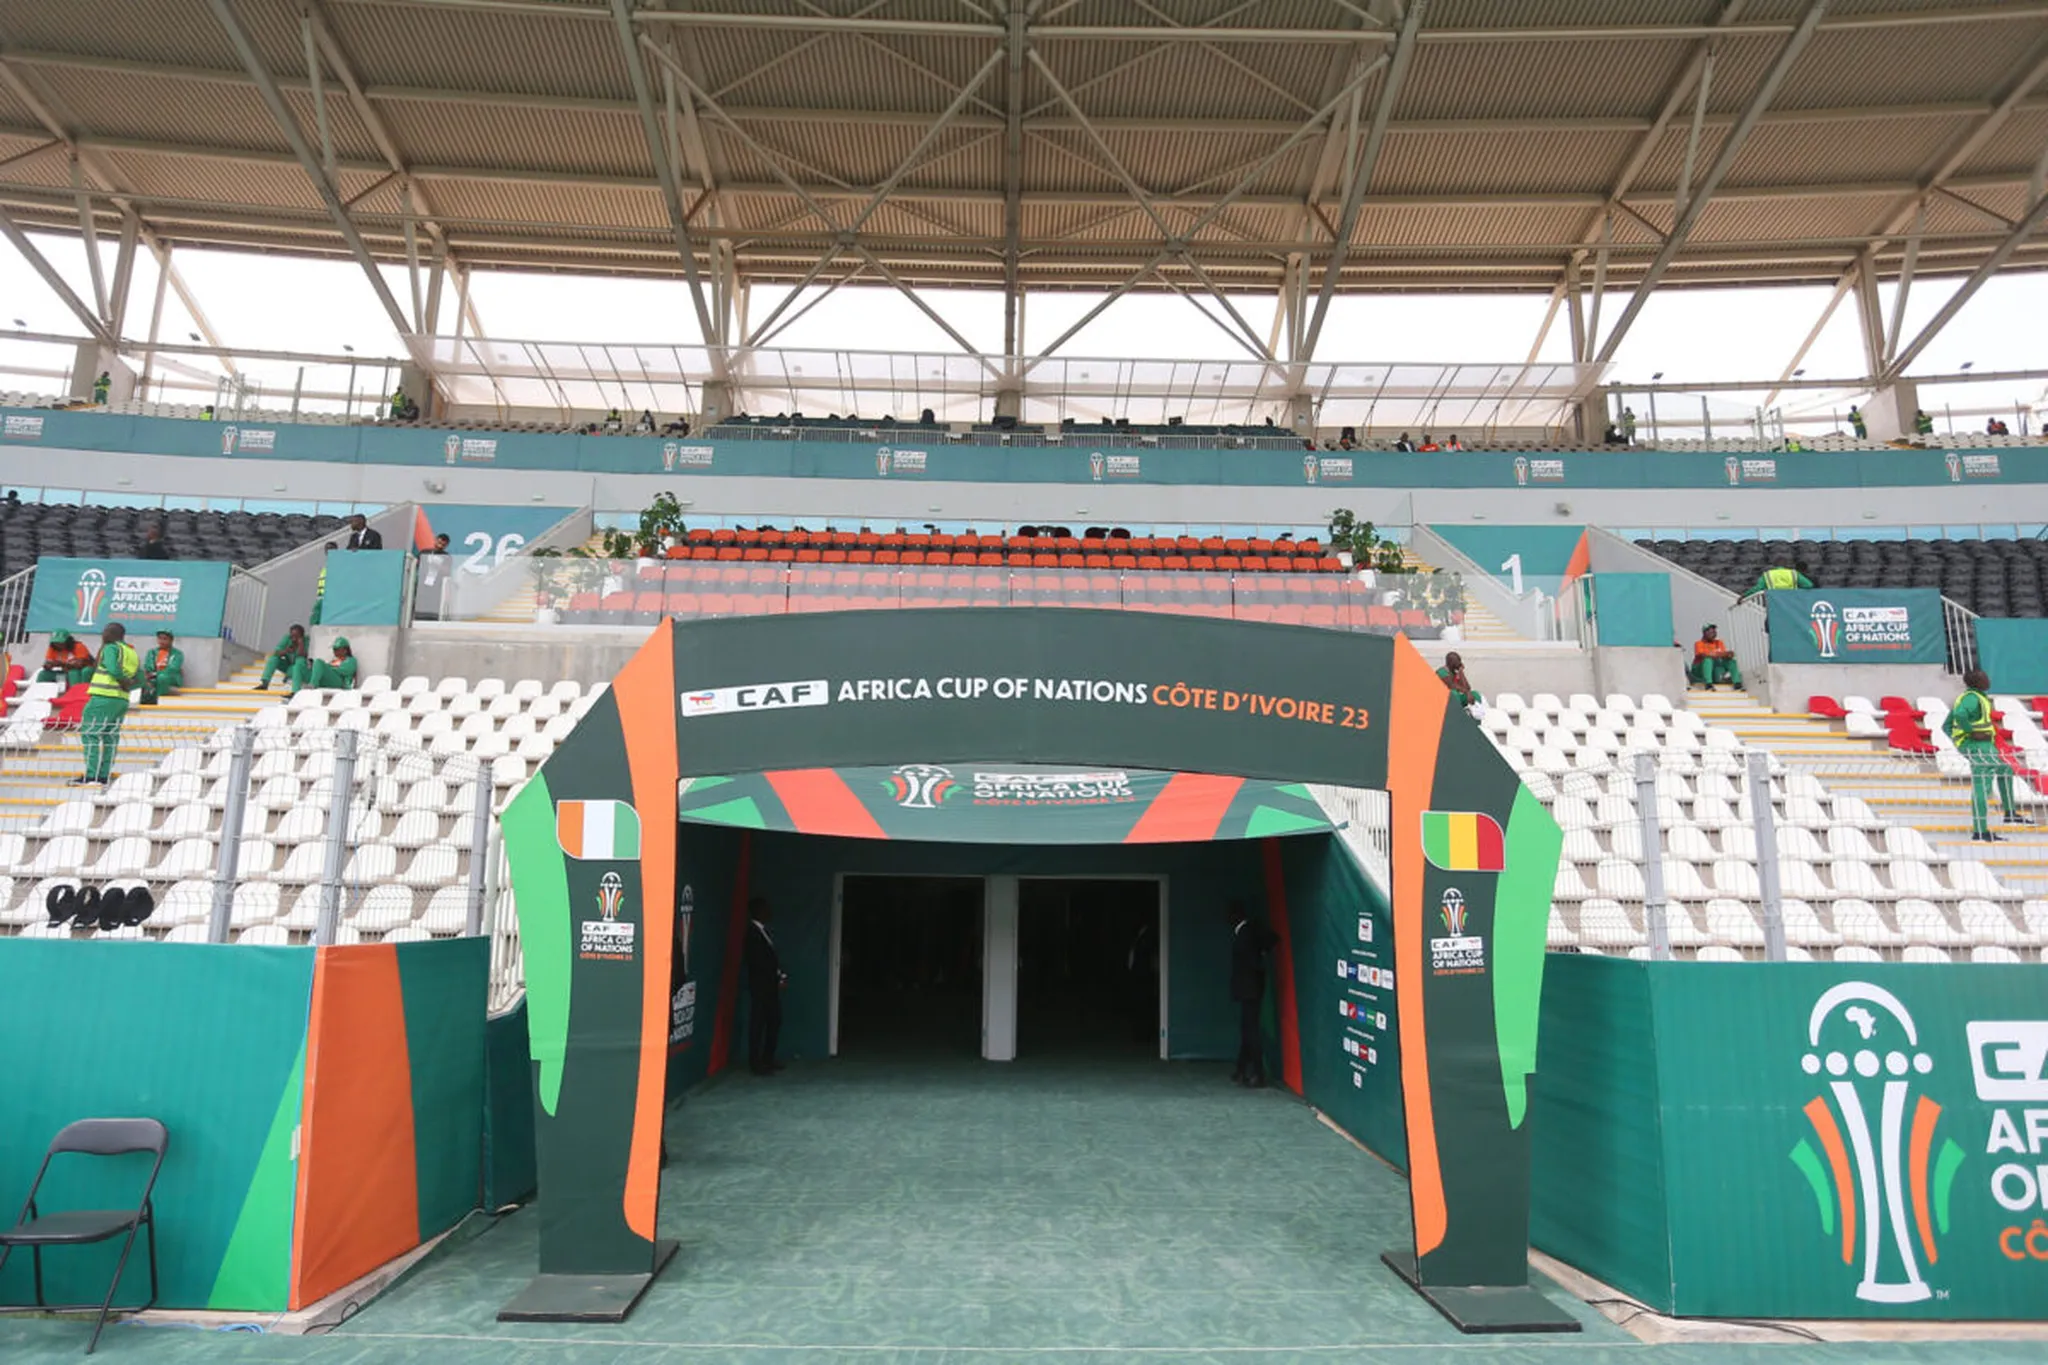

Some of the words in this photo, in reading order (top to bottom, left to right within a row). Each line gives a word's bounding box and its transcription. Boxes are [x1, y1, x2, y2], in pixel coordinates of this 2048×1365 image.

[1501, 554, 1524, 596] 1
[112, 592, 152, 603] AFRICA
[156, 594, 179, 604] CUP
[110, 602, 127, 612] OF
[128, 602, 177, 613] NATIONS
[1844, 622, 1884, 633] AFRICA
[1887, 622, 1908, 632] CUP
[1845, 632, 1861, 642] OF
[1862, 632, 1910, 642] NATIONS
[737, 684, 811, 707] CAF
[837, 678, 932, 702] AFRICA
[936, 678, 988, 699] CUP
[993, 678, 1028, 699] OF
[1035, 679, 1148, 704] NATIONS
[1152, 682, 1217, 710] CÔTE
[1341, 707, 1369, 730] 23
[1016, 788, 1133, 798] NATIONS
[581, 935, 614, 944] AFRICA
[615, 936, 634, 945] CUP
[580, 943, 592, 951] OF
[594, 944, 633, 953] NATIONS
[1433, 951, 1465, 960] AFRICA
[1465, 950, 1483, 958] CUP
[1432, 960, 1445, 969] OF
[1446, 959, 1484, 968] NATIONS
[1981, 1041, 2048, 1080] C
